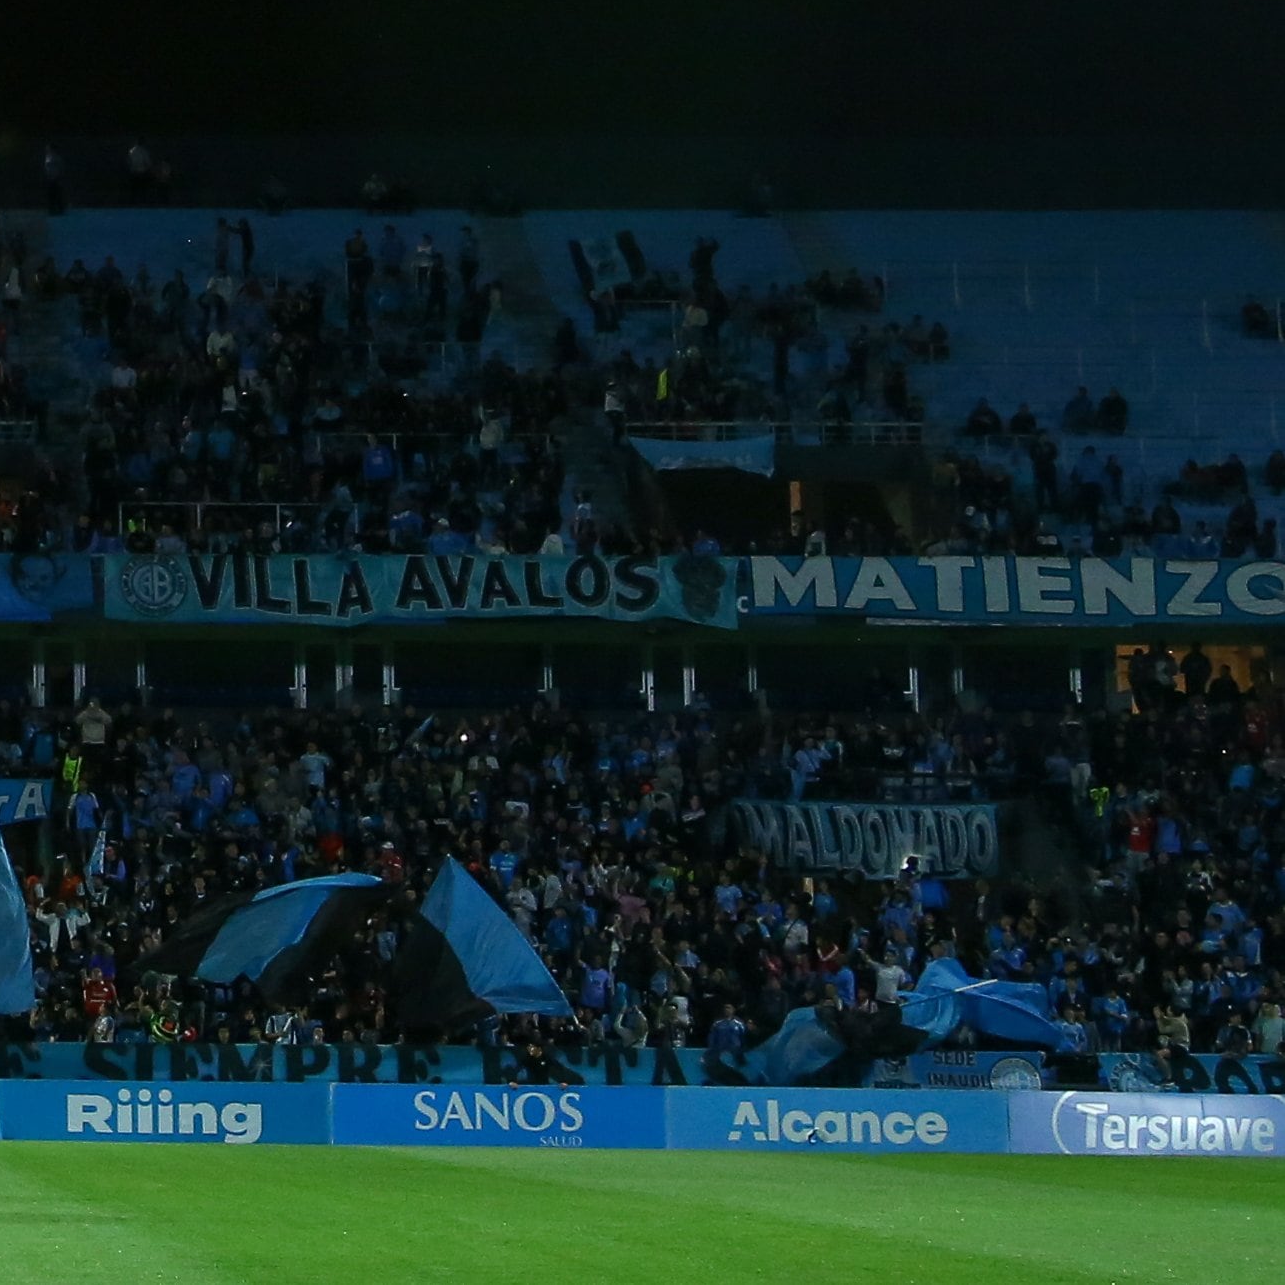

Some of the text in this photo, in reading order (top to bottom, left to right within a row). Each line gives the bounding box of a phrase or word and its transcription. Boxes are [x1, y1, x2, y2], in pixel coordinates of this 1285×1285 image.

[187, 553, 373, 617] VILLA
[395, 553, 661, 614] AVALOS
[750, 555, 1285, 616] MATIENZO
[735, 803, 998, 874] MALDONADO
[66, 1088, 263, 1144] Riiing
[413, 1090, 584, 1133] SANOS
[728, 1099, 949, 1145] Alcance
[1075, 1103, 1276, 1153] Tersuave
[539, 1135, 583, 1147] SALUD
